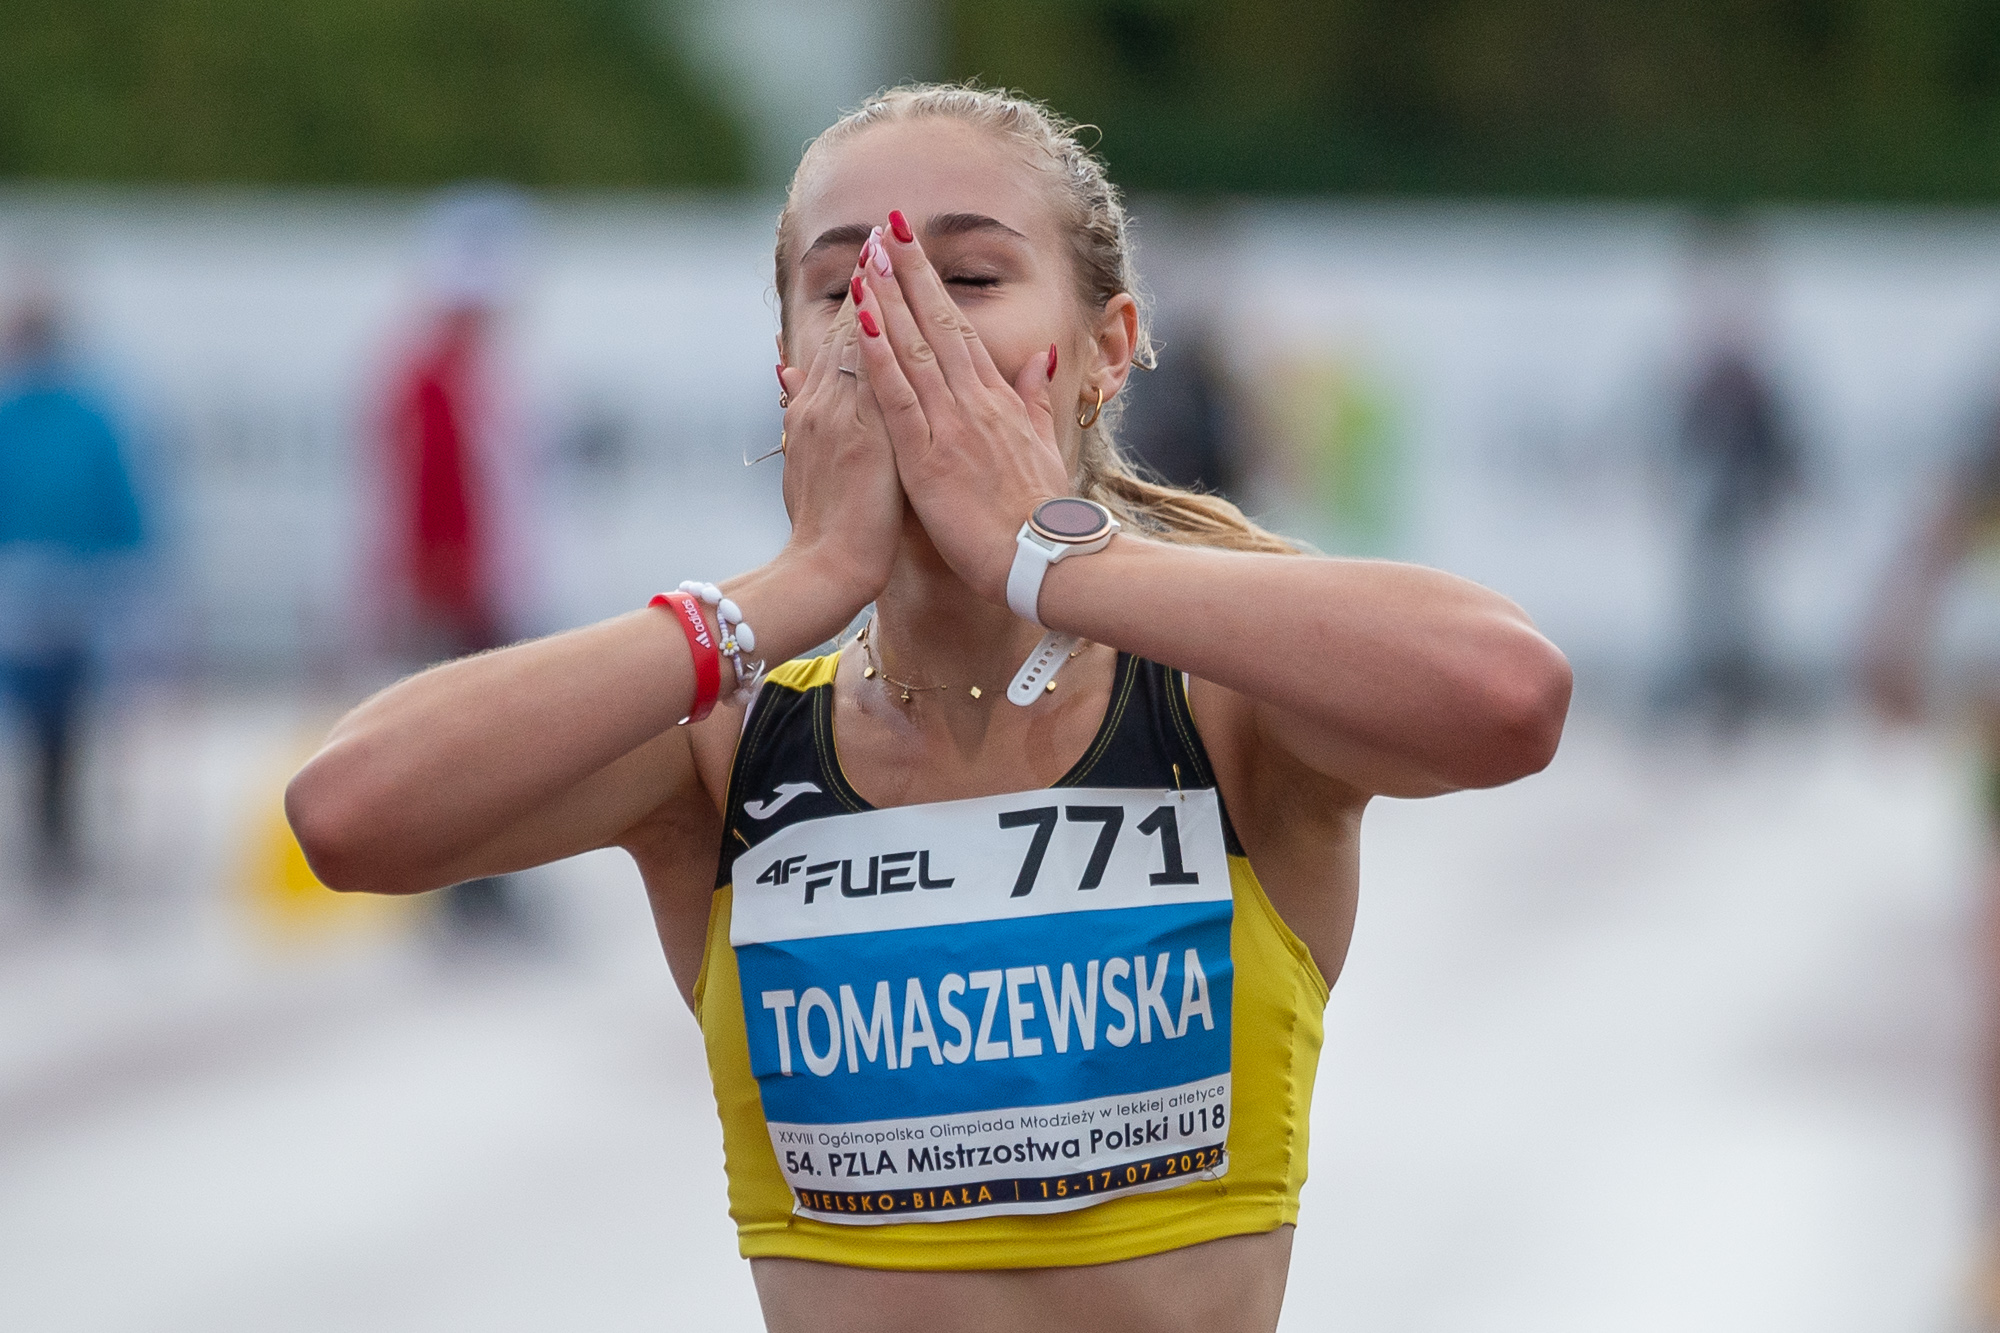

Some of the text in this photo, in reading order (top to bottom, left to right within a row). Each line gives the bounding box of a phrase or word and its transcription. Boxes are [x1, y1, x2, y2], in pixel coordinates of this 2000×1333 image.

[682, 599, 705, 632] adidas
[998, 806, 1200, 898] 771
[761, 948, 1215, 1077] TOMASZEWSKA
[779, 1084, 1225, 1149] XXVIII Ogólnopolska Olimpiada Młodzieży w lekkiej atletyce
[786, 1103, 1225, 1177] 54. PZLA Mistrzostwa Polski U18
[801, 1185, 993, 1212] BIELSKO-BIAŁA
